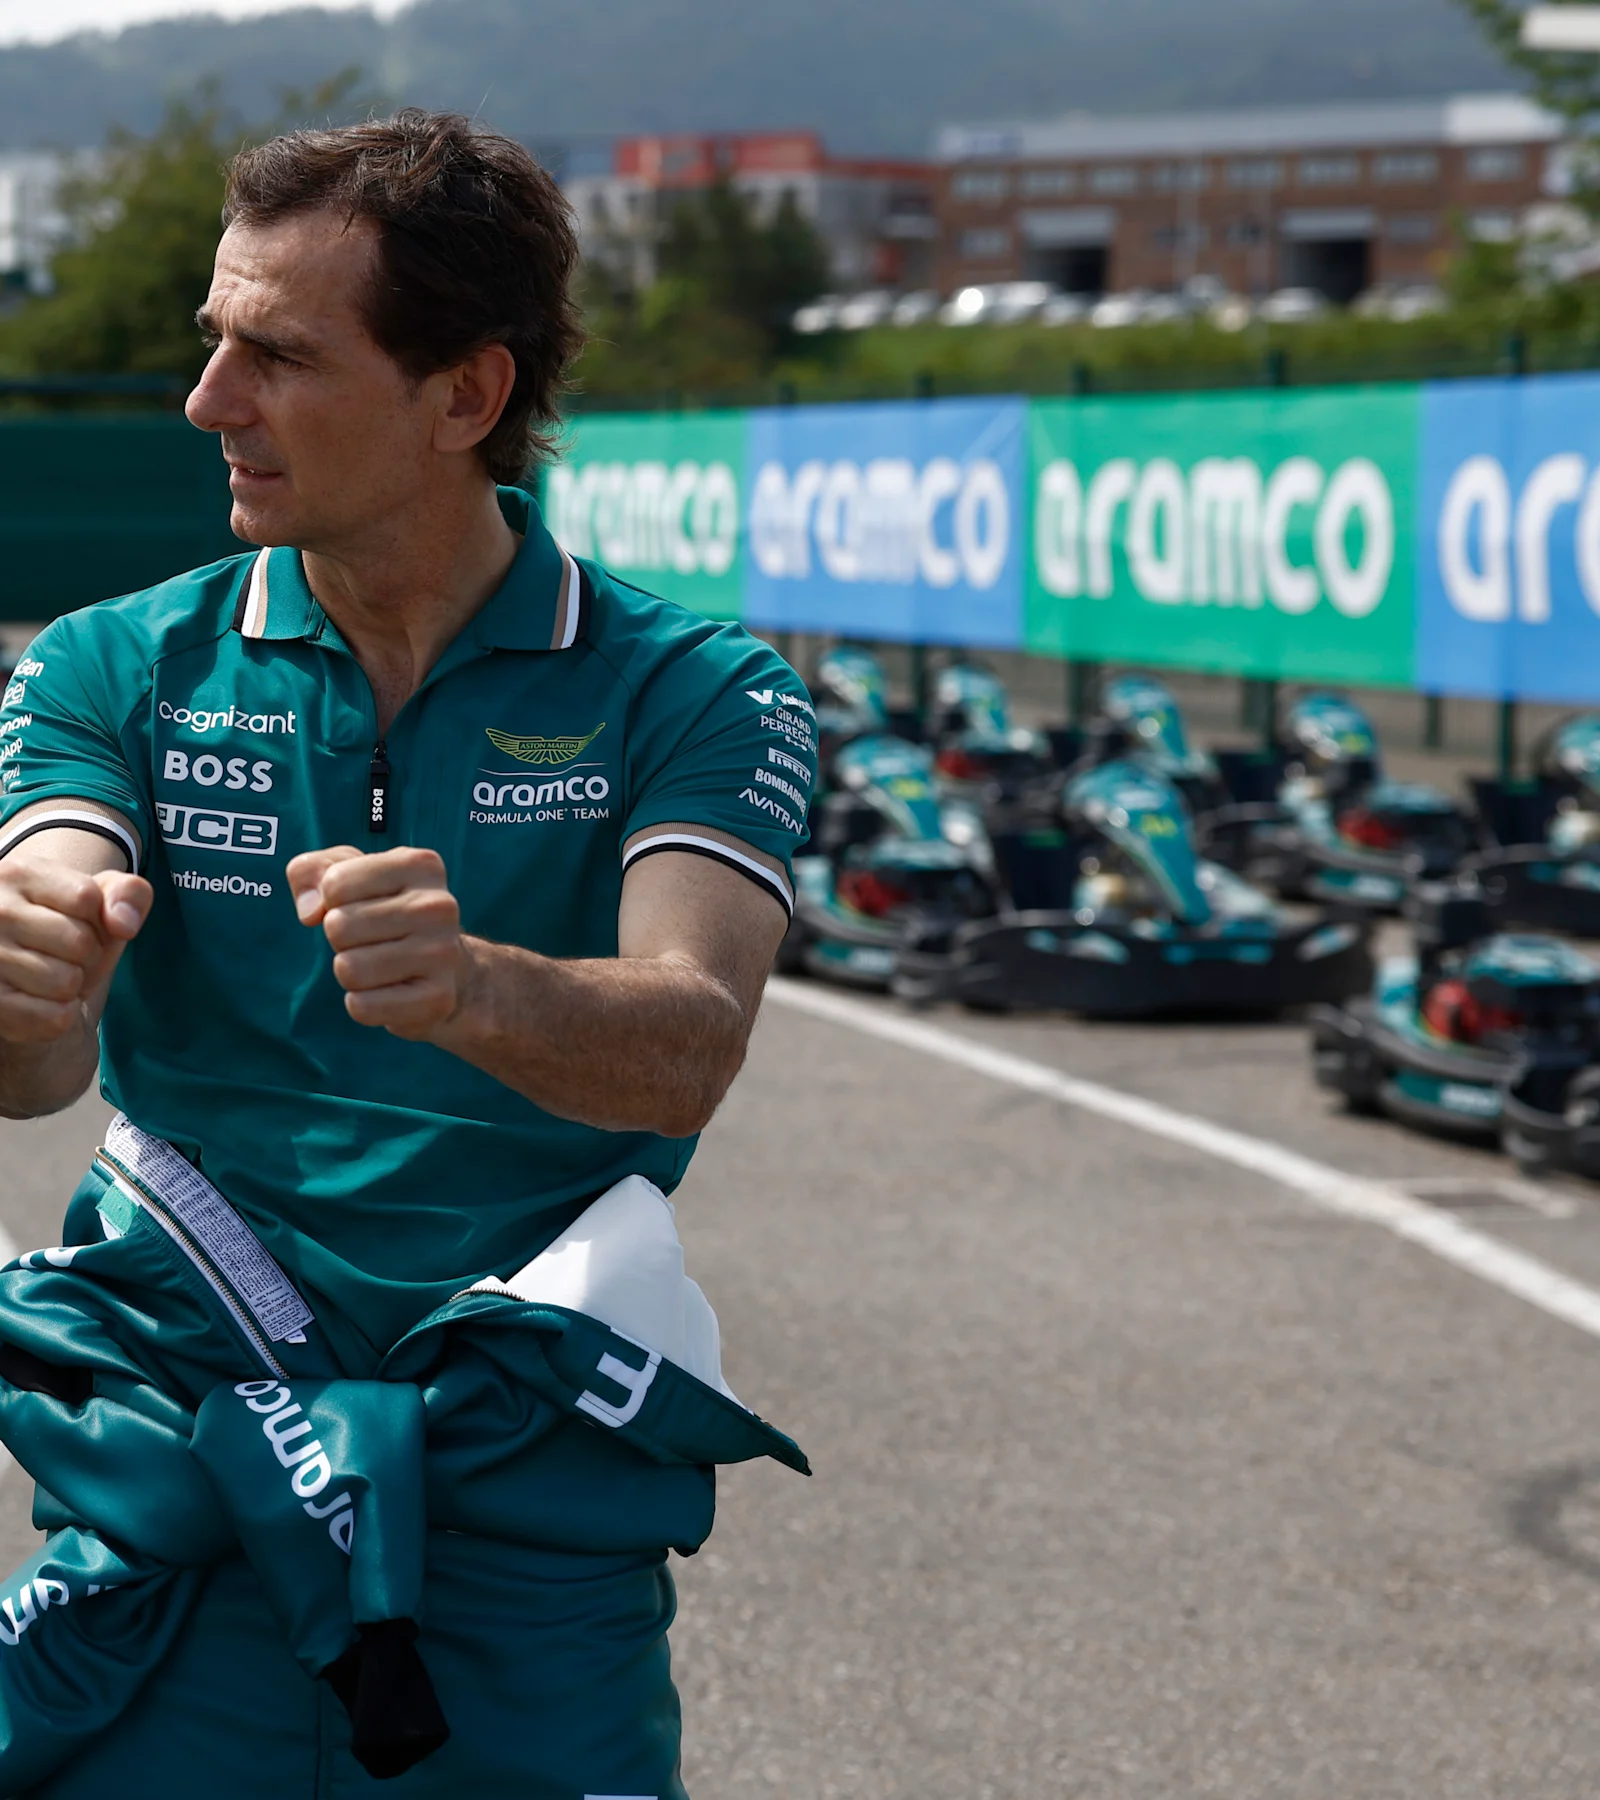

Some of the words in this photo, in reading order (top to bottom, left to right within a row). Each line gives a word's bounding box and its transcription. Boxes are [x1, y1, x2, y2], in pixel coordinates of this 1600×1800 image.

[750, 456, 1010, 592] aramco
[1034, 454, 1396, 620] aramco
[158, 700, 296, 735] Cognizant
[776, 706, 812, 735] GIRARD
[520, 742, 546, 750] ASTON
[547, 742, 578, 750] MARTIN
[163, 749, 274, 793] BOSS
[371, 788, 384, 822] BOSS
[473, 775, 610, 807] aramco
[158, 807, 273, 850] JCB
[469, 810, 533, 824] FORMULA
[572, 807, 610, 820] TEAM
[171, 869, 273, 898] ntinelOne
[234, 1379, 355, 1556] aramco
